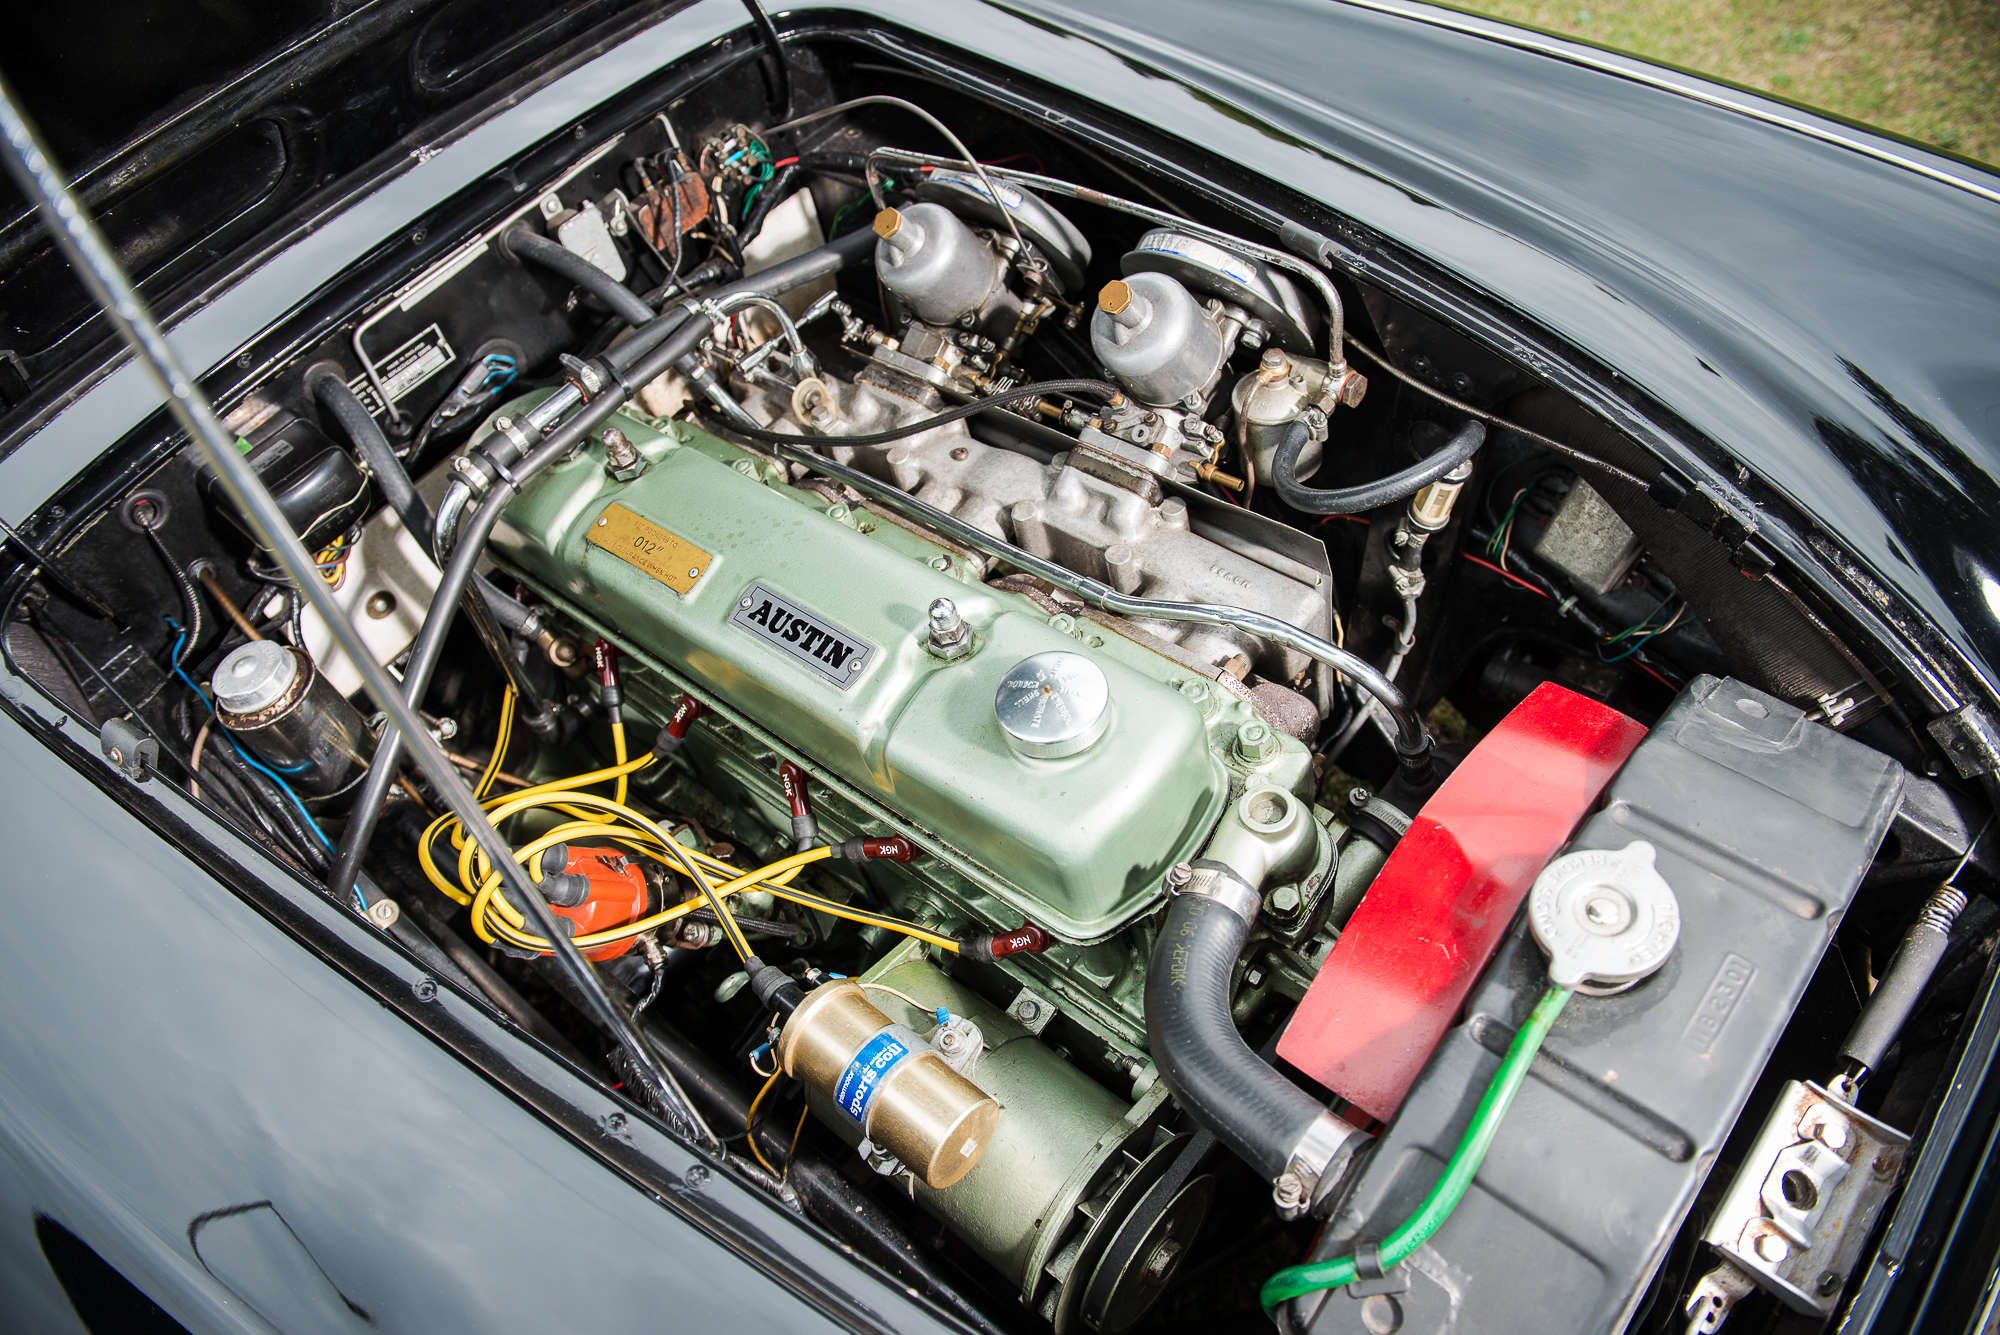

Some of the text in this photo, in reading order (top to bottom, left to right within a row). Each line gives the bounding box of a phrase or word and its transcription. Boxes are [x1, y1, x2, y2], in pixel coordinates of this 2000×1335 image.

[748, 600, 855, 670] AUSTIN
[674, 704, 688, 722] NGK
[782, 773, 793, 797] NGK
[879, 845, 899, 855] NGK
[1010, 934, 1031, 949] NGK
[849, 1068, 878, 1117] sports
[876, 1043, 903, 1068] coil
